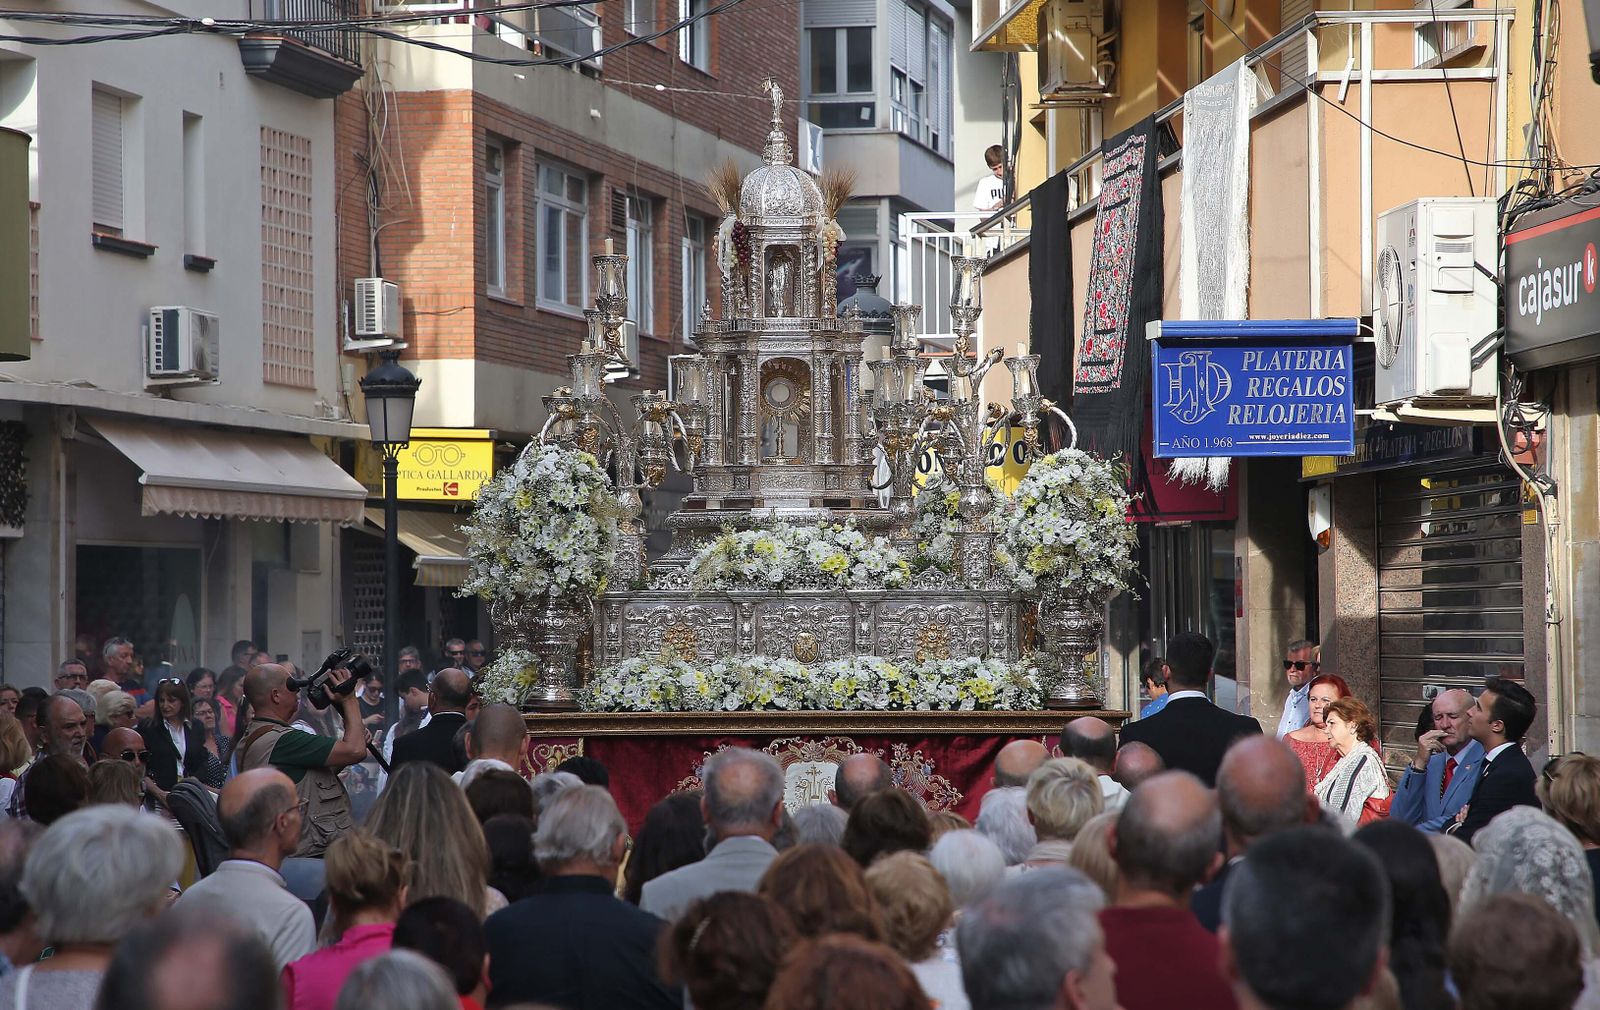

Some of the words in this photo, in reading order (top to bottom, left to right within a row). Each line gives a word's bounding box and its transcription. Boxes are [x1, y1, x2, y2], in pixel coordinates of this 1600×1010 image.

[1518, 257, 1582, 326] cajasur
[1241, 349, 1346, 371] PLATERIA
[1246, 375, 1346, 398] REGALOS
[1226, 404, 1346, 425] RELOJERIA
[1171, 435, 1200, 449] AÑO
[1204, 436, 1233, 448] 1.968
[1248, 432, 1330, 441] www.joyeriadiez.com
[1424, 425, 1463, 452] REGALOS
[426, 469, 488, 481] GALLARDO
